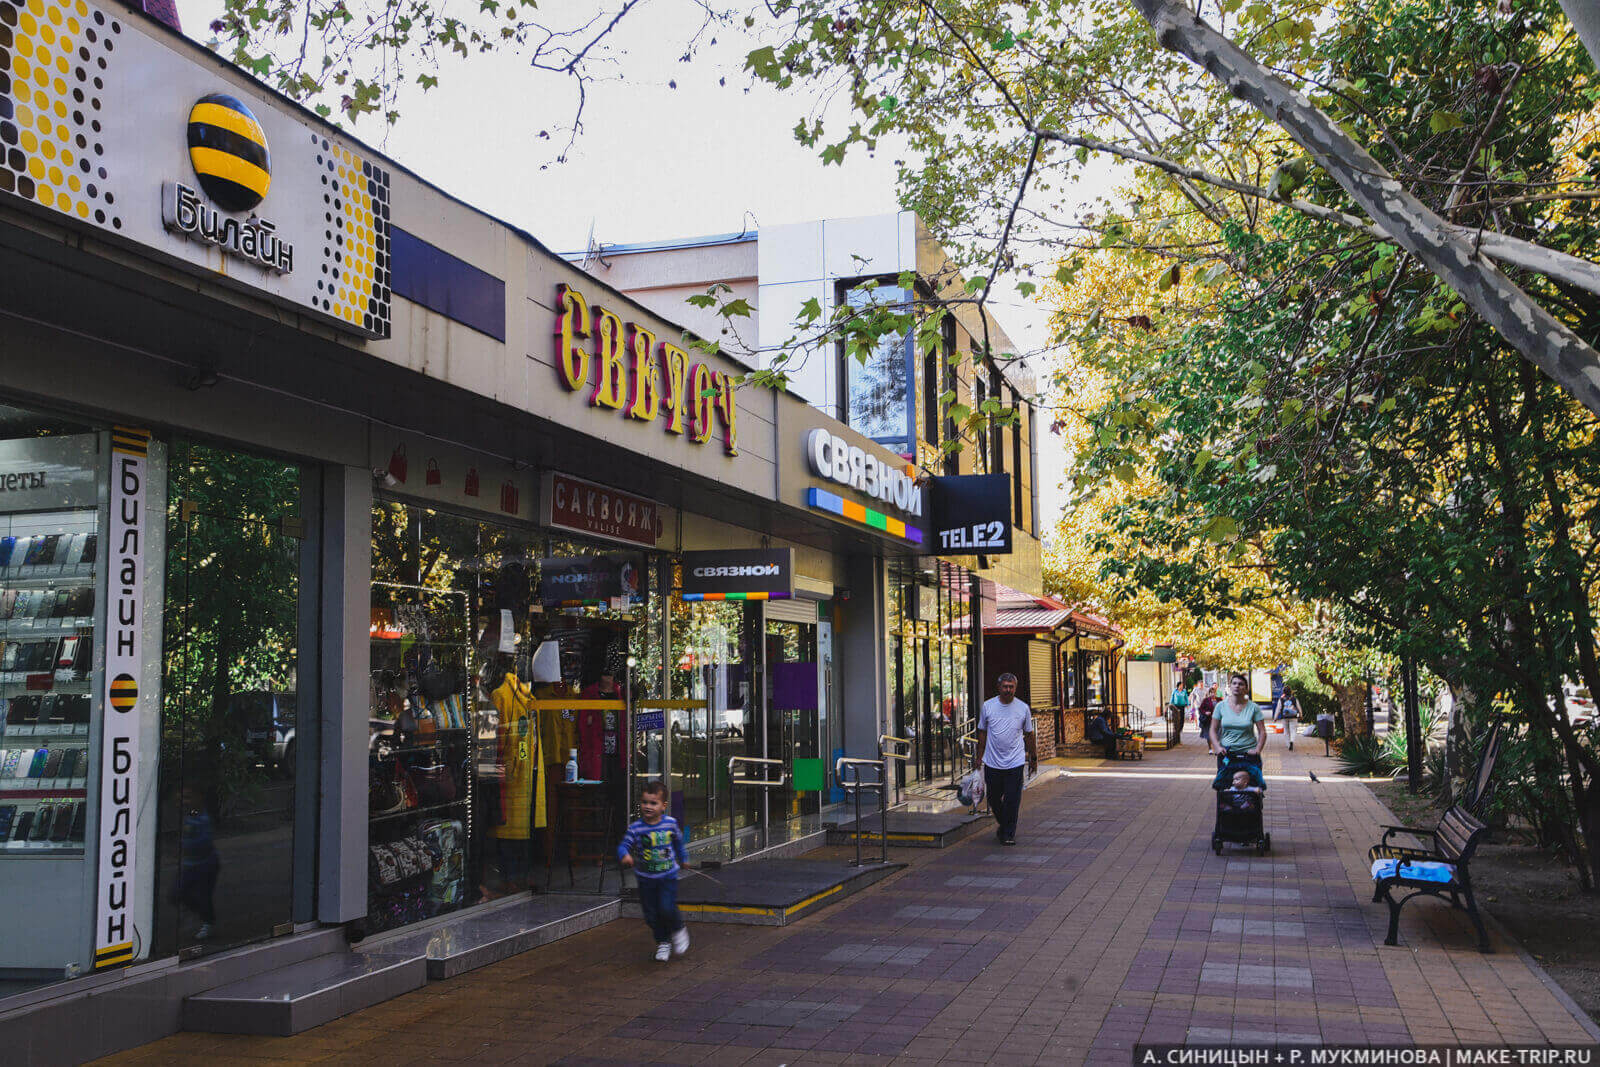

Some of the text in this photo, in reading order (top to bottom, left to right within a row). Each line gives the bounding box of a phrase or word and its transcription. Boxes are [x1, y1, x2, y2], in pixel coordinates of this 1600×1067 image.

[175, 182, 294, 274] Билайн
[555, 283, 739, 457] СВЕТОЧ
[555, 482, 652, 530] САКВОЯЖ
[808, 428, 922, 517] СВЯЗНОЙ
[117, 458, 140, 657] Билайн
[693, 563, 780, 577] СВЯЗНОЙ
[939, 521, 1005, 549] TELE2
[107, 737, 131, 943] Билайн
